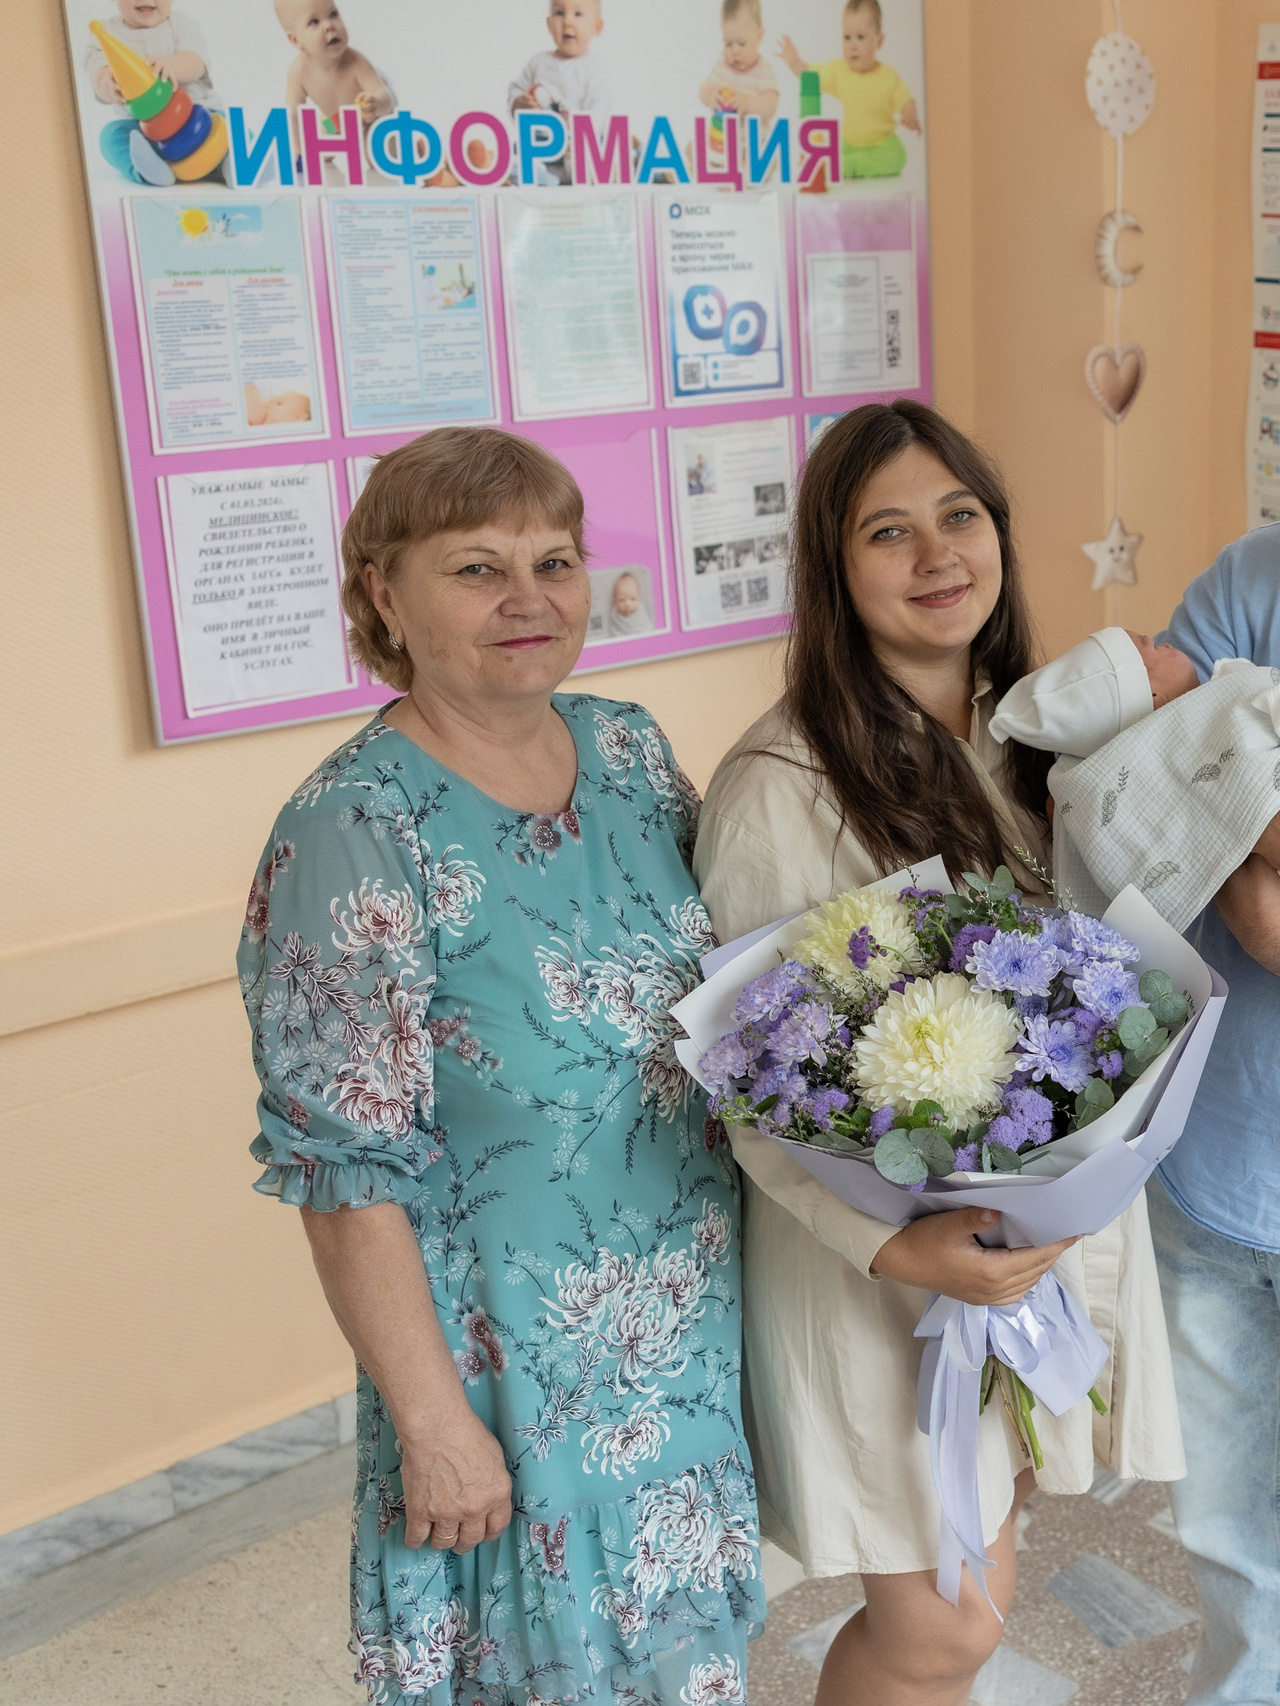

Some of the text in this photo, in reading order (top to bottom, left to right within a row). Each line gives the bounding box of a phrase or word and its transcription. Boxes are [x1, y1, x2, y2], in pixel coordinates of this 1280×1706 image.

[227, 106, 841, 192] ИНФОРМАЦИЯ
[191, 480, 265, 496] УВАЖАЕМЫЕ
[203, 524, 297, 542] СВИДЕТЕЛЬСТВО
[198, 537, 314, 557] РОЖДЕНИИ РЕБЕНКА
[200, 561, 223, 573] ДЛЯ
[225, 552, 306, 569] РЕГИСТРАЦИИ
[194, 574, 246, 588] ОРГАНАХ
[289, 563, 324, 576] БУДЕТ
[191, 590, 238, 606] ТОЛЬКО
[250, 577, 329, 595] ЭЛЕКТРОННОМ
[203, 622, 228, 633] ОНО
[276, 613, 292, 623] НА
[294, 608, 326, 620] ВАШЕ
[221, 634, 247, 646] ИМЯ
[263, 623, 311, 639] ЛИЧНЫЙ
[219, 644, 272, 660] КАБИНЕТ
[274, 642, 289, 652] НА
